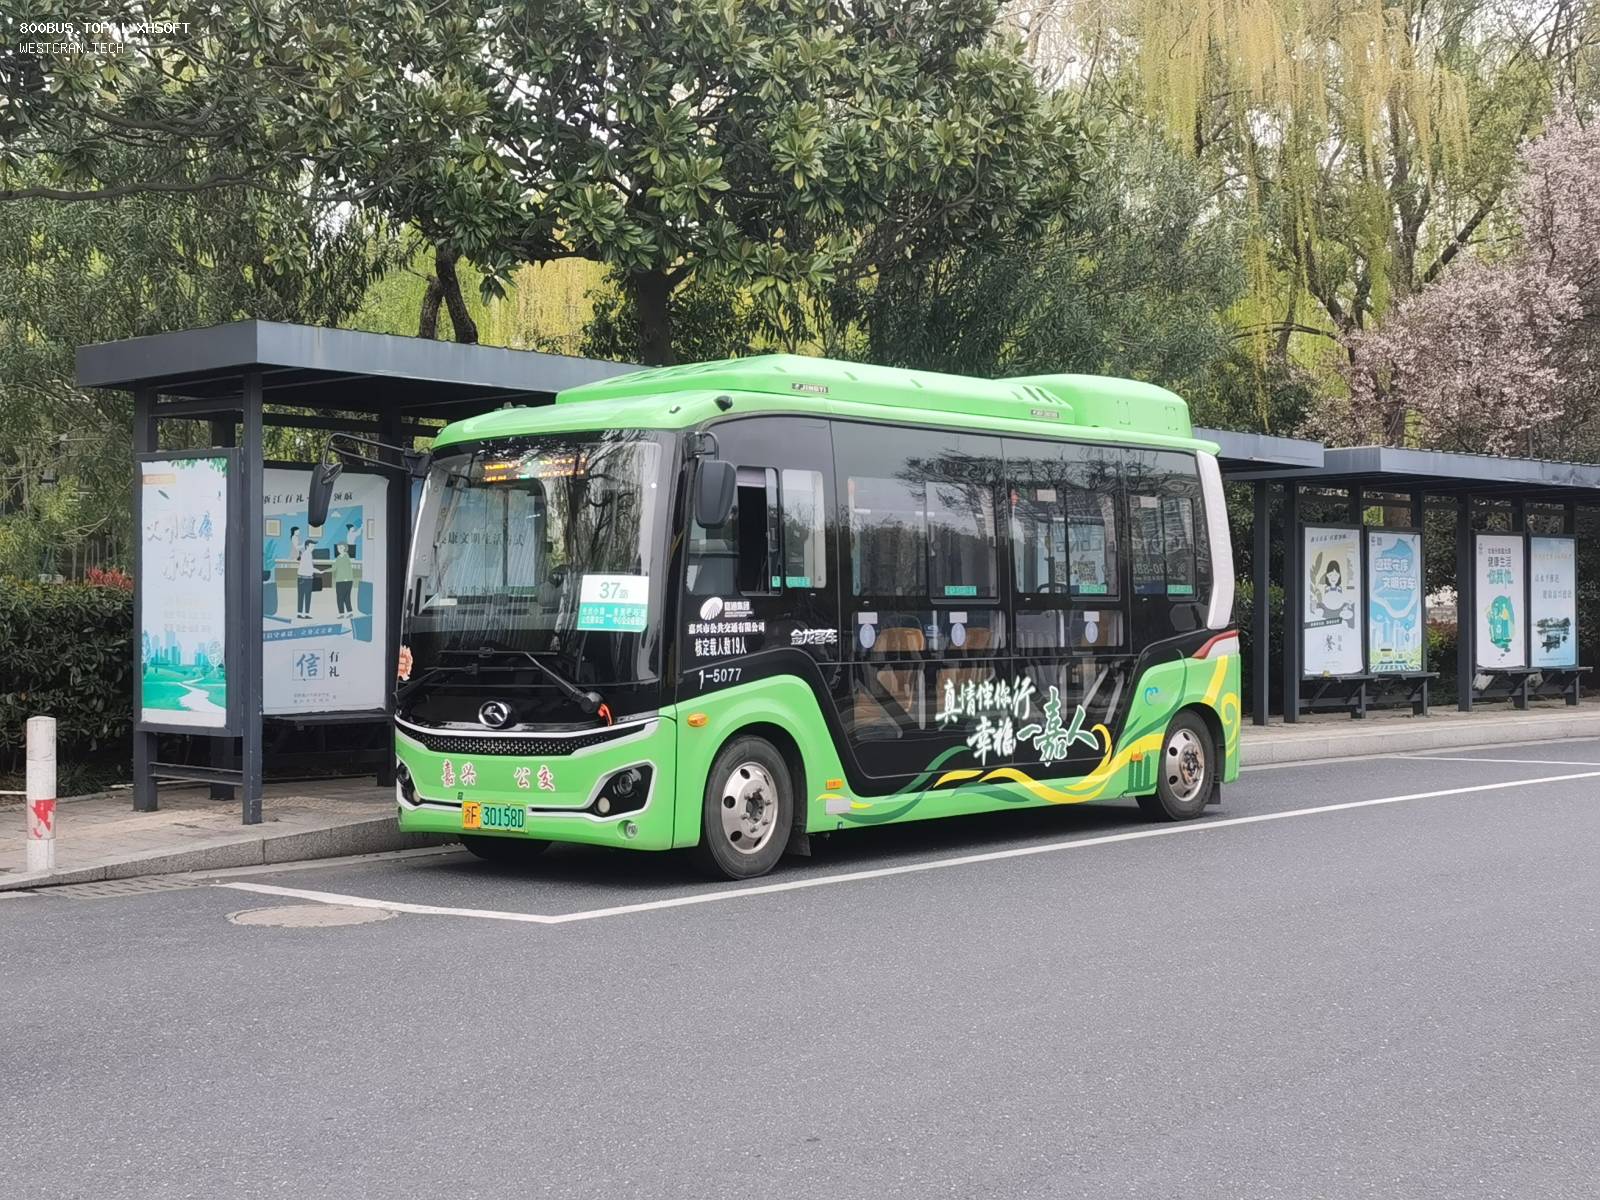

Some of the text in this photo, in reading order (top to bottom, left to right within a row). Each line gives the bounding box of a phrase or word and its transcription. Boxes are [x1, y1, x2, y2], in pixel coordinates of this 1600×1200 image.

[688, 621, 765, 635] 嘉兴市公共交通有限公司
[790, 628, 838, 646] 金龙客车
[694, 636, 747, 657] 核定载人数19人
[296, 653, 320, 677] 信
[698, 667, 742, 690] 1-5077
[935, 675, 1037, 731] 真情伴你行
[441, 758, 555, 791] 嘉兴 公交
